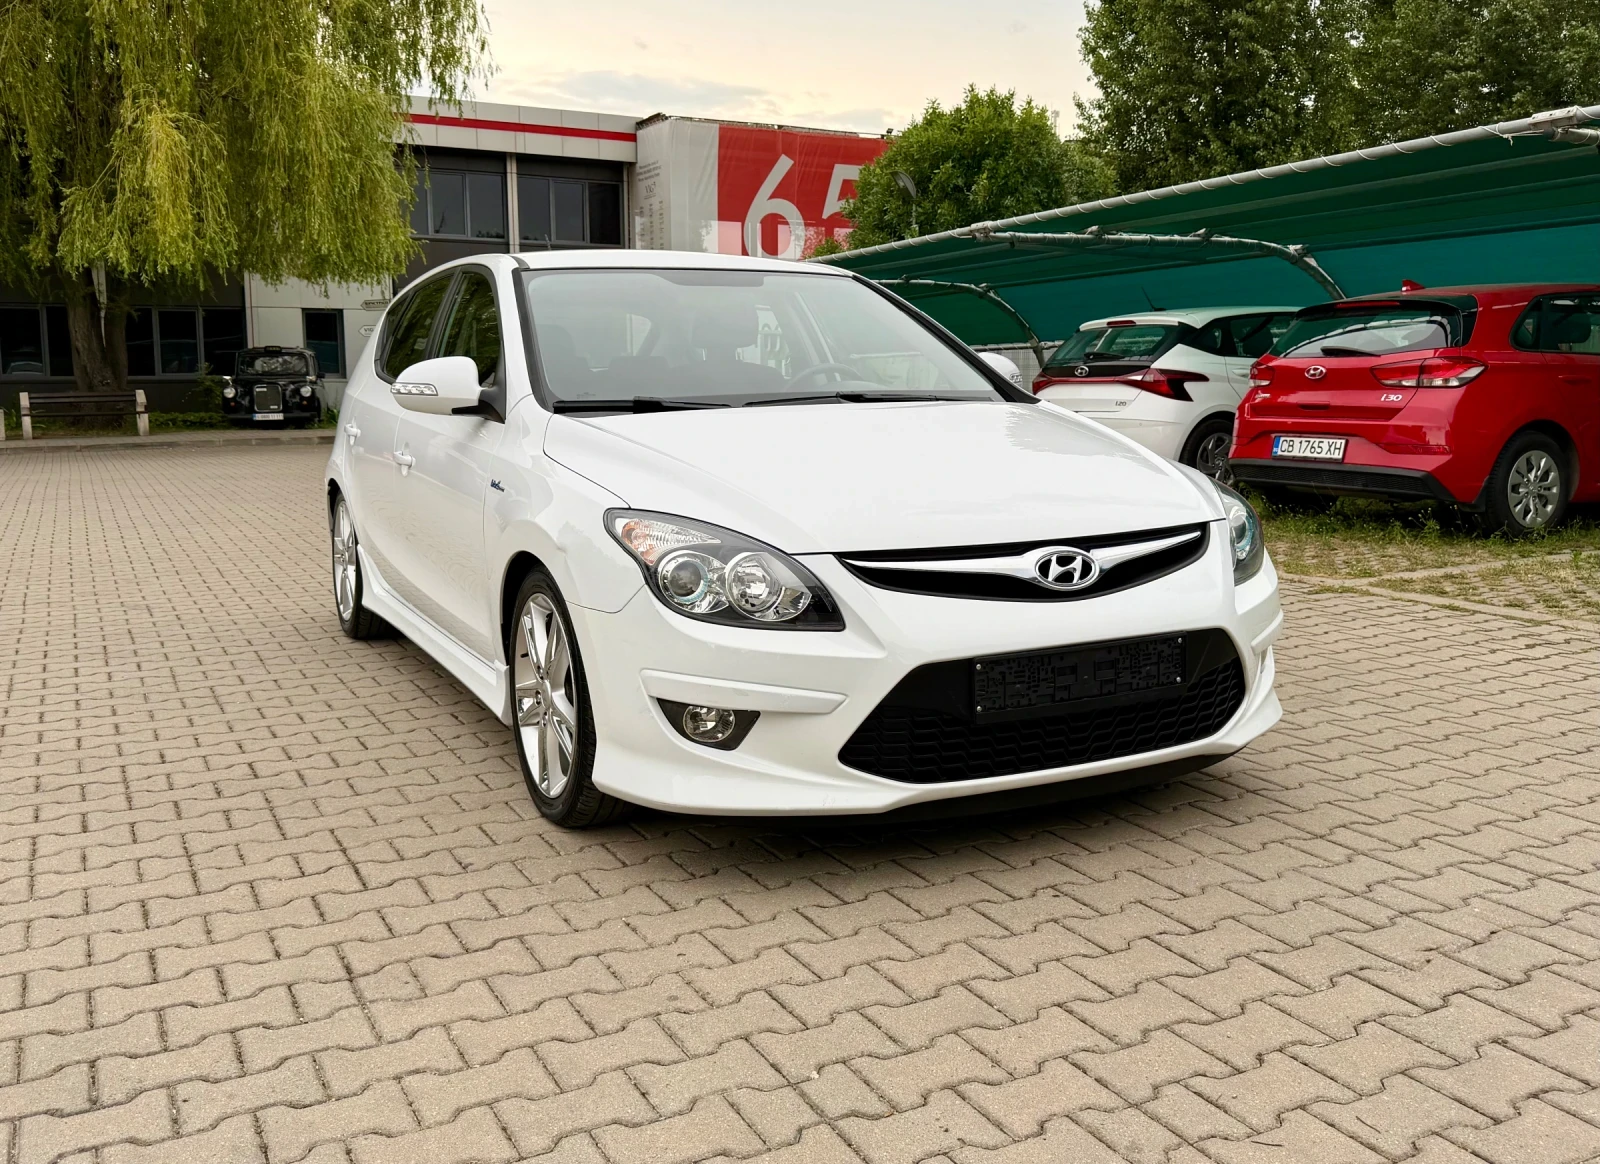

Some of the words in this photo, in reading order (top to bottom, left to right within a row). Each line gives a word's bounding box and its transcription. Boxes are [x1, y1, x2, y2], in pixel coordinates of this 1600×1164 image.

[1280, 439, 1295, 453] CB
[1298, 440, 1324, 455] 1765
[1326, 441, 1343, 456] XH
